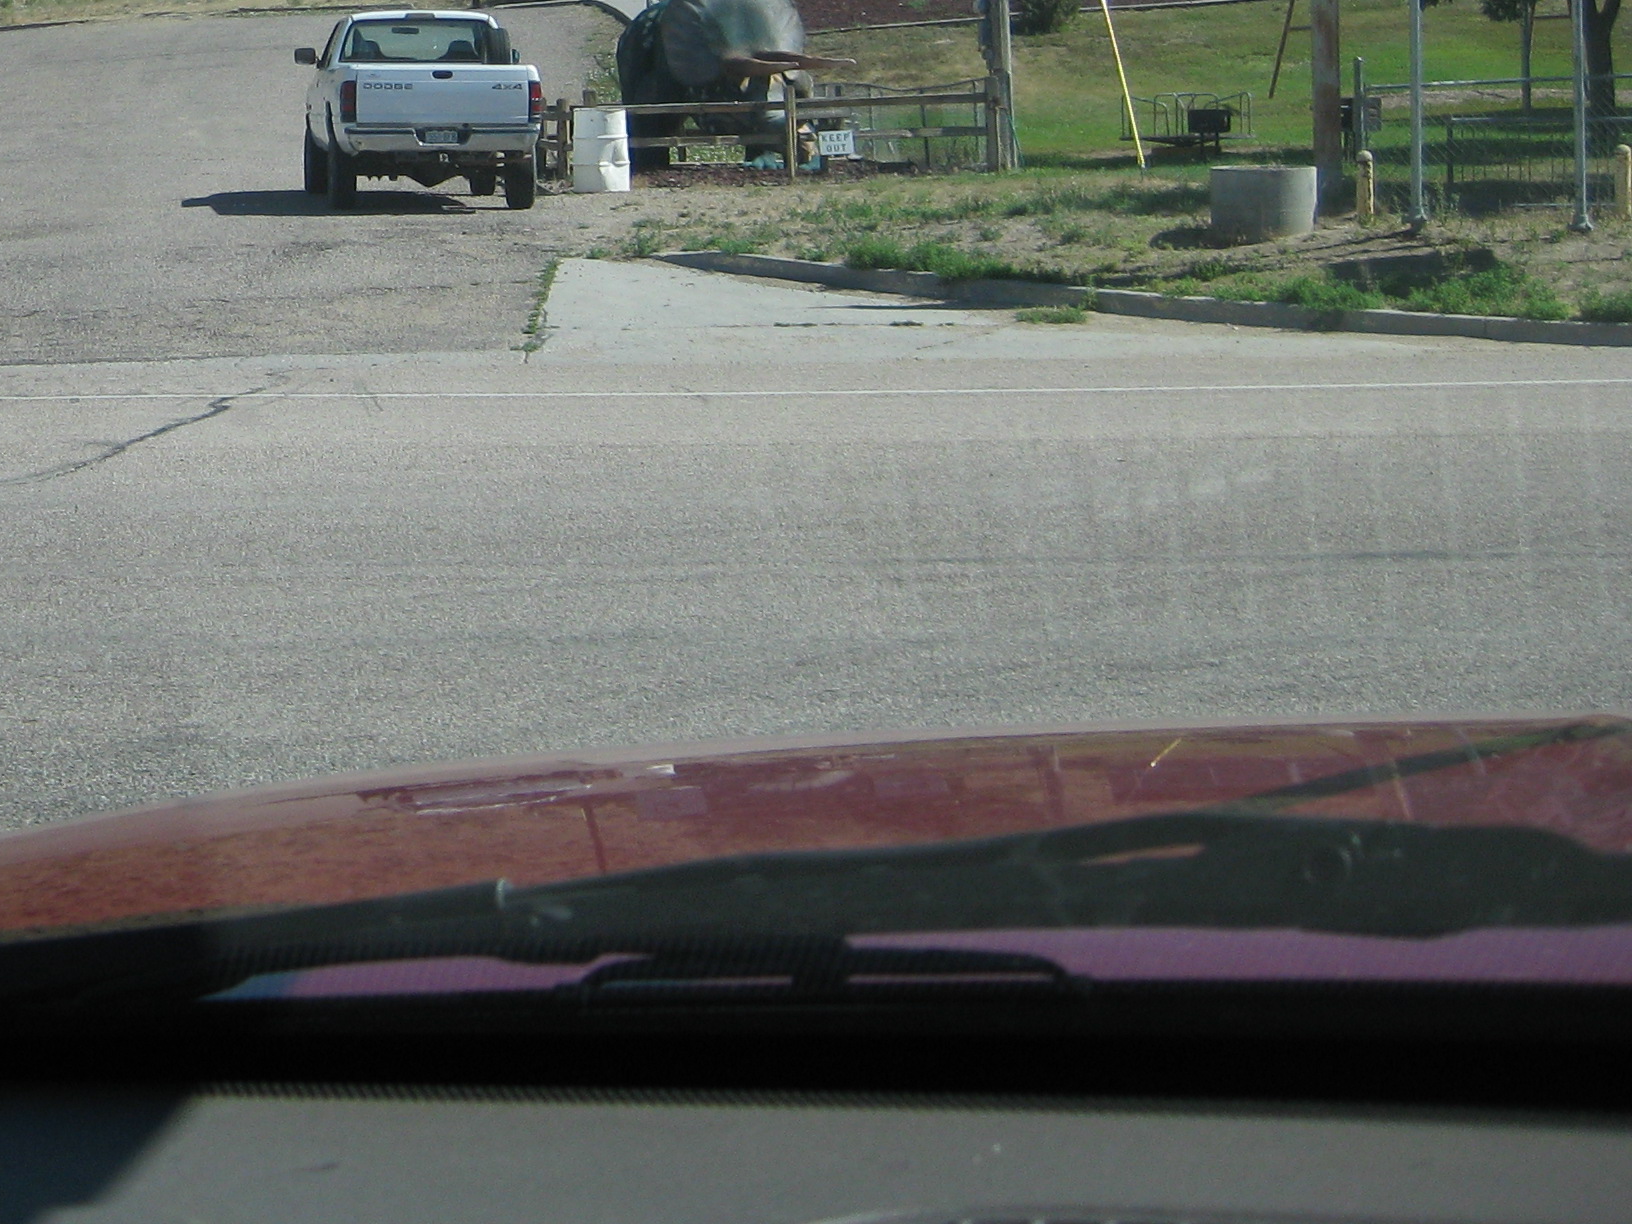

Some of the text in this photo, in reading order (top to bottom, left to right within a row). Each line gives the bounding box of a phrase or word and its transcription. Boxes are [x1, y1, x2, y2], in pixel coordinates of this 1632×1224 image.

[363, 82, 413, 90] DODGE
[821, 132, 850, 142] KEEP
[826, 143, 847, 153] OUT
